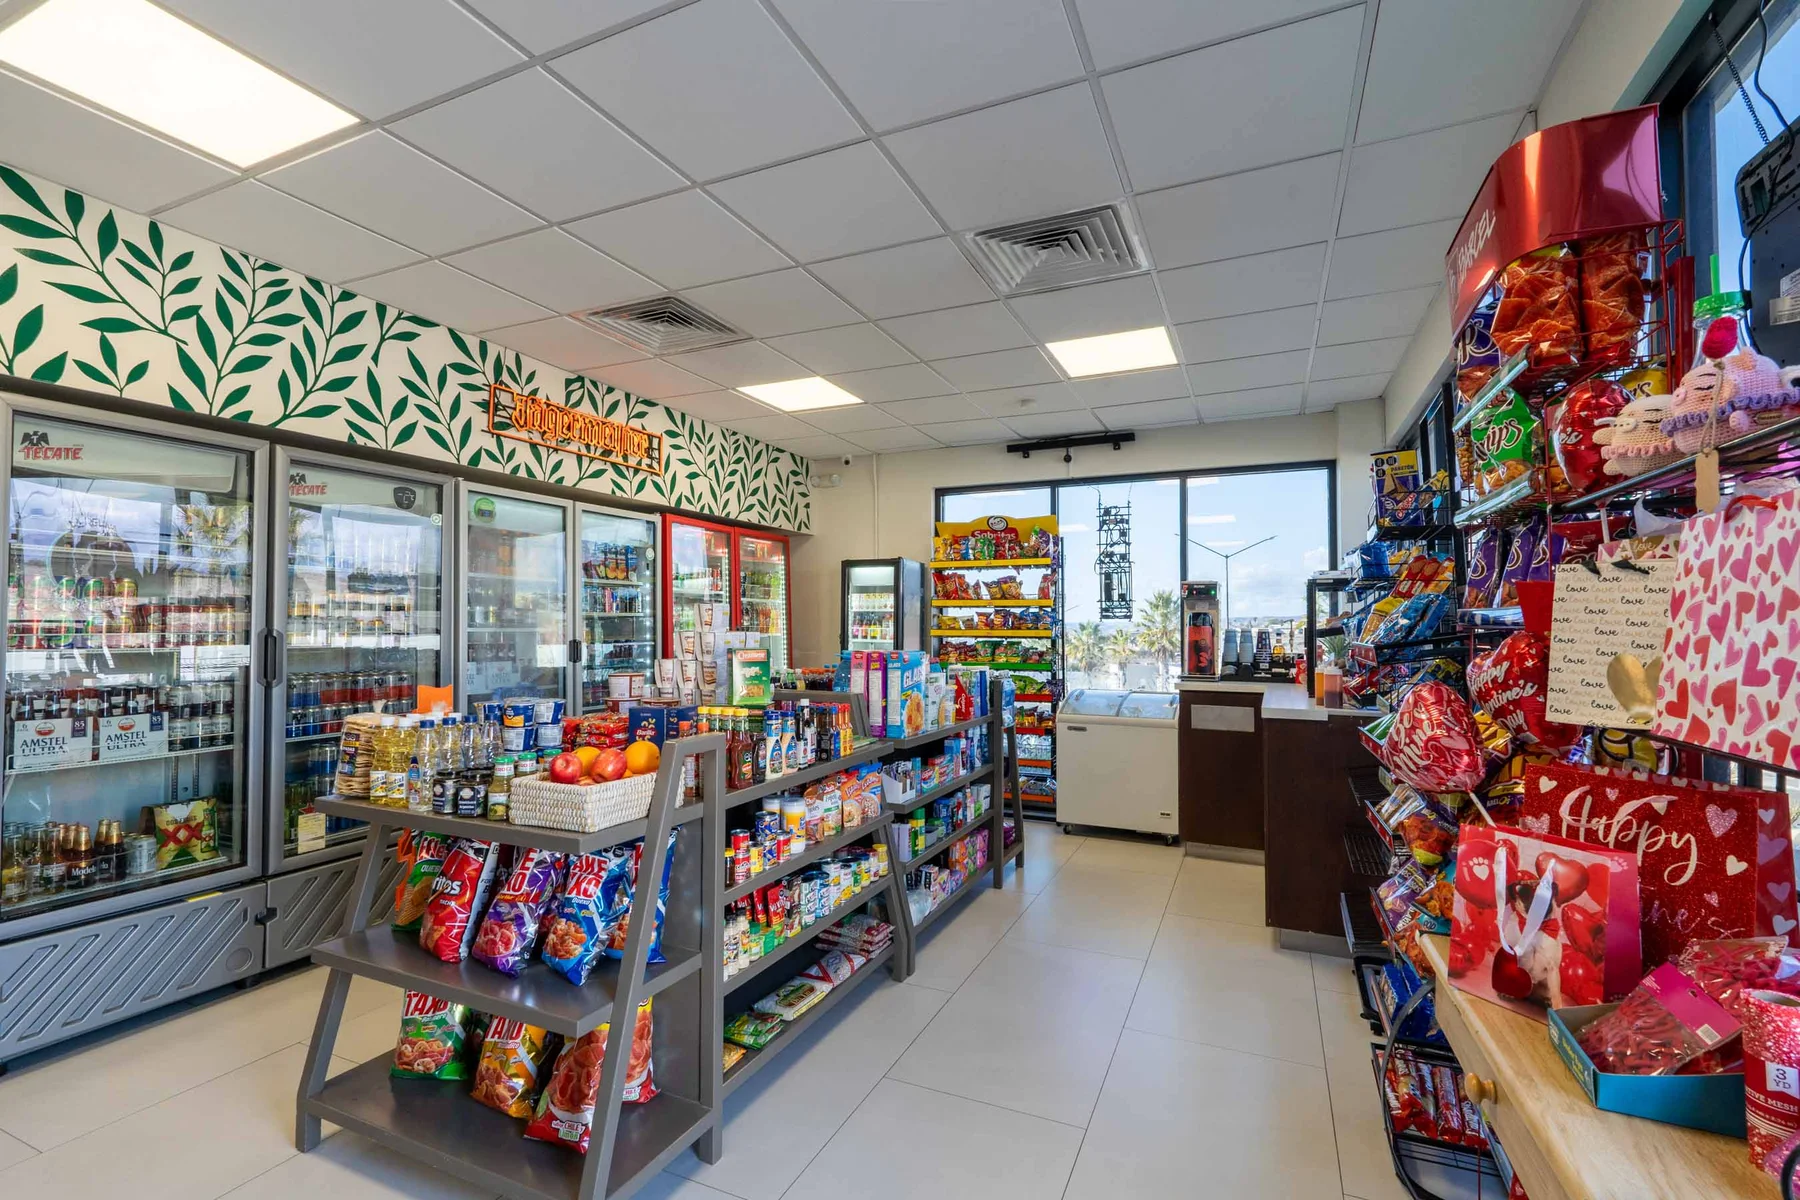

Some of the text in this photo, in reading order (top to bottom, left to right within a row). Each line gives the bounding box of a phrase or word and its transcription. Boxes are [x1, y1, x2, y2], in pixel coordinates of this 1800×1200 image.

[18, 445, 84, 460] TECATE
[288, 483, 328, 496] TECATE
[973, 531, 1017, 541] Sabritas
[1557, 565, 1579, 573] love
[1597, 573, 1622, 583] love
[1566, 584, 1589, 593] love
[1643, 585, 1670, 594] love
[1621, 595, 1645, 605] love
[1584, 606, 1608, 615] love
[1625, 618, 1650, 627] love
[1594, 626, 1619, 636] love
[1553, 635, 1577, 644] love
[1631, 640, 1657, 650] love
[1596, 648, 1619, 657] love
[1563, 655, 1587, 665] love
[1580, 678, 1605, 688] love
[1549, 704, 1573, 715] love
[1591, 700, 1616, 710] love
[151, 715, 161, 723] 85
[74, 720, 85, 729] 85
[21, 736, 68, 749] AMSTEL
[105, 731, 148, 744] AMSTEL
[1559, 786, 1704, 886] Happy
[1776, 1068, 1787, 1080] 3
[1773, 1079, 1792, 1090] YD
[1767, 1097, 1799, 1113] MESH
[564, 1121, 580, 1130] CHILE
